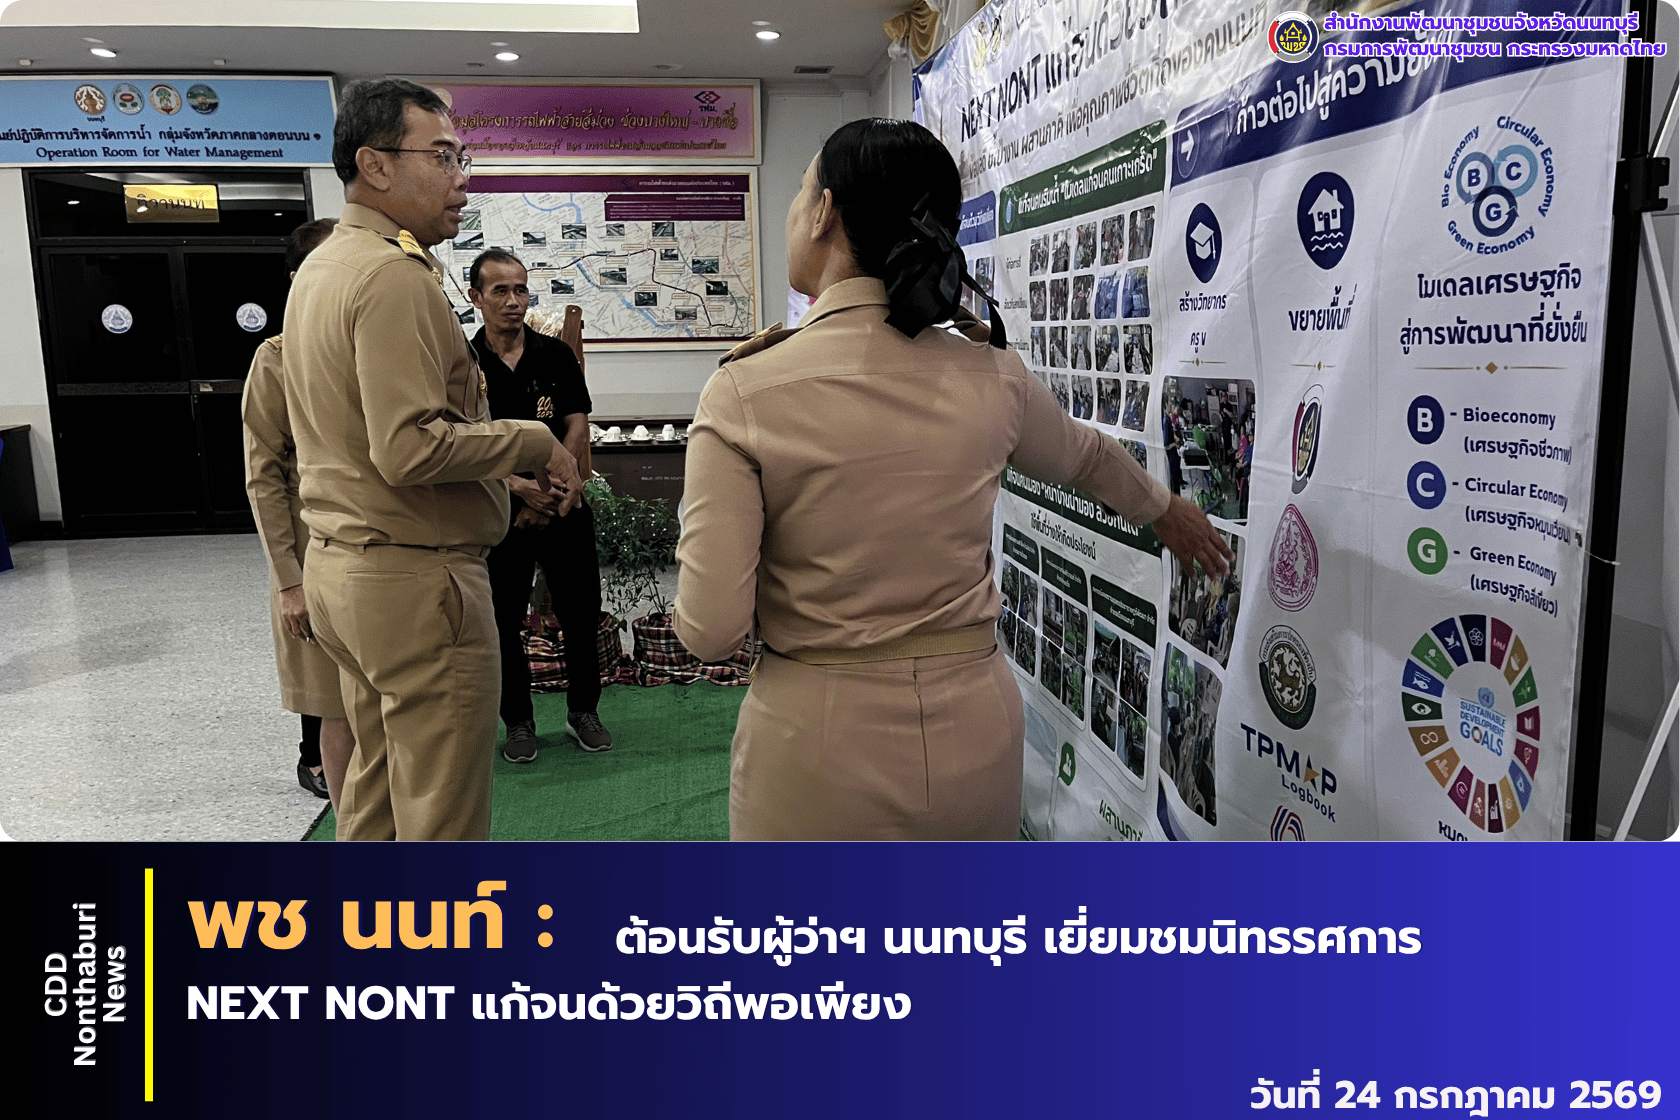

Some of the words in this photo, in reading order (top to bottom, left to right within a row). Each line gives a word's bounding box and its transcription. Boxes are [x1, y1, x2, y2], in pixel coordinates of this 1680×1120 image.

[997, 53, 1041, 122] NONT
[450, 106, 615, 134] ้อมูลโครงการรถไฟฟ้าสายสีม่วง
[36, 147, 98, 161] Operation
[101, 147, 138, 157] Room
[143, 146, 160, 157] for
[165, 147, 200, 157] Water
[204, 147, 284, 160] Management
[1444, 125, 1480, 180] Economy
[1496, 115, 1544, 148] Circular
[1537, 147, 1555, 218] Economy
[1467, 168, 1481, 187] B
[1505, 161, 1522, 181] C
[1441, 183, 1450, 208] Bio
[1485, 202, 1502, 222] G
[1448, 220, 1474, 251] Green
[1477, 225, 1536, 255] Economy
[1417, 262, 1582, 298] โมเดลเศรษฐกิจ
[1179, 290, 1227, 312] สร้างวิทยากร
[1288, 284, 1357, 331] ขยายพื้นที่
[1190, 332, 1200, 353] ครู
[1400, 301, 1588, 355] สู่การพัฒนาที่ยั่งยืน
[1417, 407, 1434, 433] B
[1463, 407, 1556, 431] Bioeconomy
[1464, 436, 1572, 465] (เศรษฐกิจชีวภาพ)
[1416, 472, 1435, 498] C
[1465, 477, 1526, 497] Circular
[1529, 484, 1569, 512] Economy
[1465, 505, 1571, 546] (เศรษฐกิจหมุนเวียน)
[1417, 538, 1437, 563] G
[1470, 546, 1515, 566] Green
[1518, 554, 1557, 586] Economy
[1470, 574, 1558, 618] (เศรษฐกิจสีเขียว)
[1460, 701, 1506, 728] SUSTAINABLE
[1460, 711, 1505, 738] DEVELOPMENT
[1460, 721, 1503, 757] GOALS
[1240, 722, 1337, 796] TPMAP
[1281, 773, 1336, 823] Logbook
